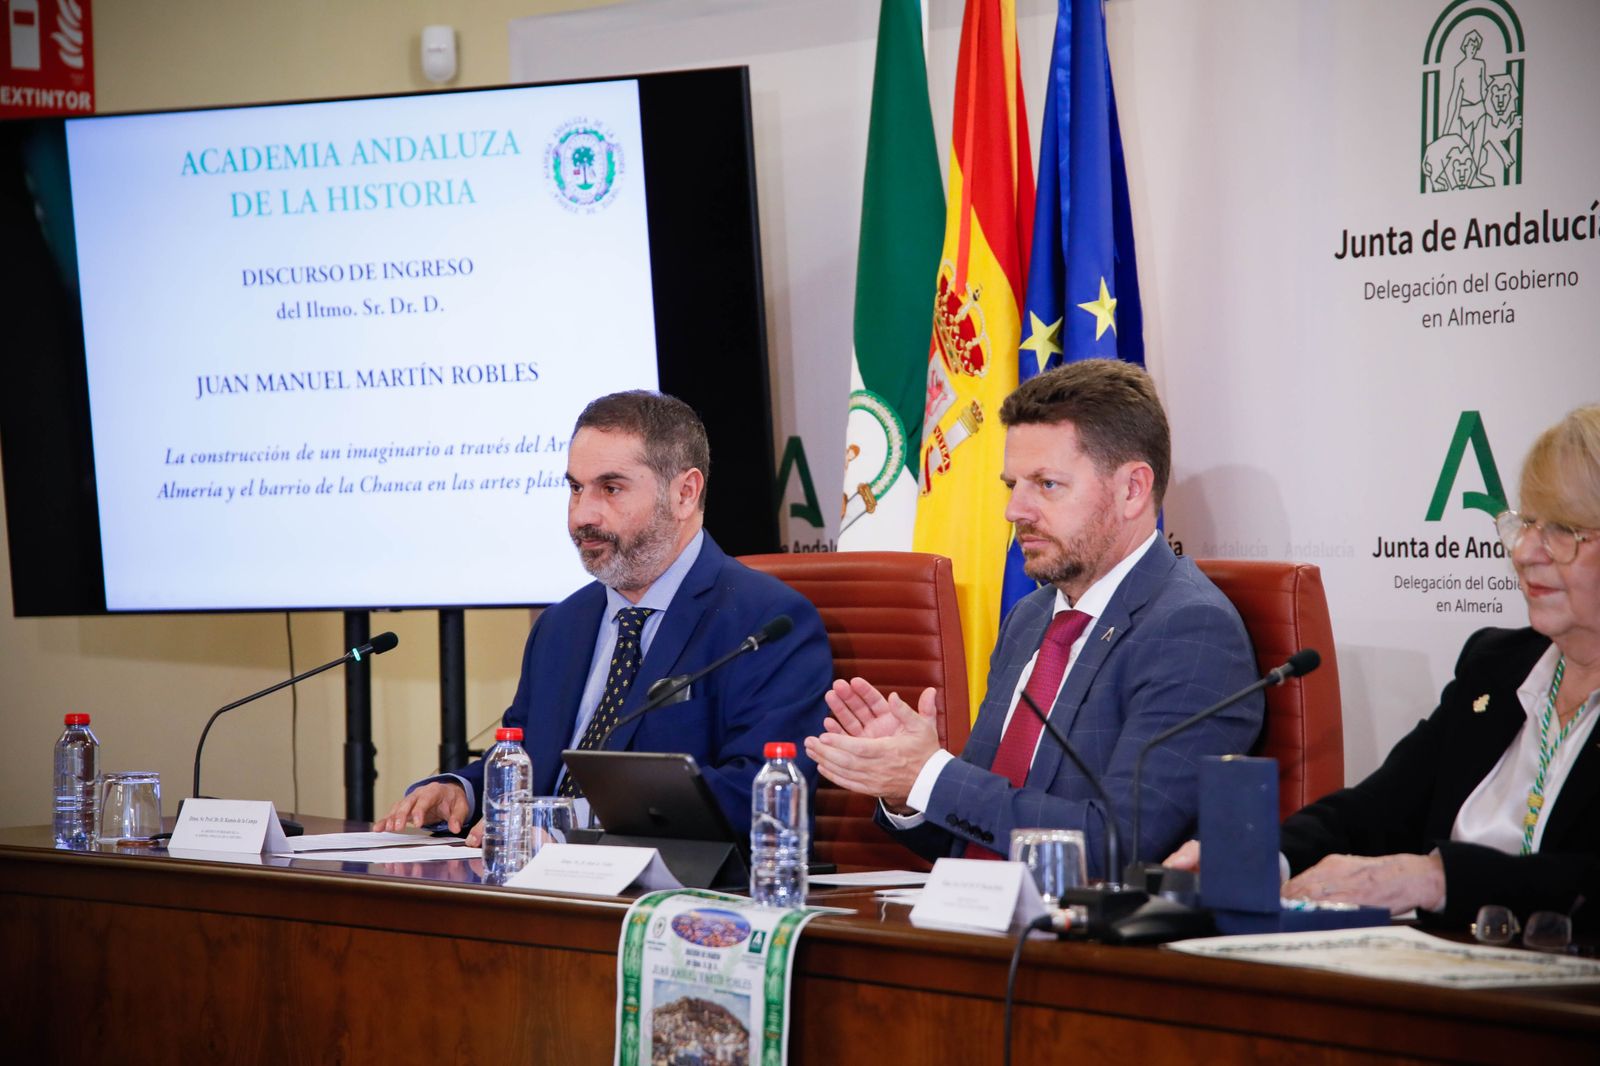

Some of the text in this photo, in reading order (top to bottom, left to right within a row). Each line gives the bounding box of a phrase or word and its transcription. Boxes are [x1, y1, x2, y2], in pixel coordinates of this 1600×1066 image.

[0, 86, 91, 111] EXTINTOR
[181, 129, 521, 176] ACADEMIA ANDALUZA
[230, 178, 478, 218] DE LA HISTORIA
[1334, 226, 1413, 260] Junta
[1422, 219, 1456, 253] de
[242, 258, 474, 287] DISCURSO DE INGRESO
[1364, 269, 1579, 303] Delegación del Gobierno
[276, 295, 444, 320] del Iltmo. Sr. Dr. D.
[1422, 302, 1515, 328] en Almería
[195, 362, 539, 400] JUAN MANUEL MARTÍN ROBLES
[165, 448, 185, 465] La
[190, 445, 290, 464] construcción
[296, 443, 314, 461] de
[320, 449, 341, 460] un
[347, 441, 440, 464] imaginario
[444, 445, 454, 456] a
[460, 438, 510, 455] través
[515, 435, 540, 453] del
[157, 481, 222, 499] Almería
[225, 487, 235, 503] y
[240, 478, 254, 496] el
[259, 478, 311, 496] barrio
[315, 477, 333, 494] de
[338, 476, 354, 493] la
[360, 475, 422, 493] Chanca
[428, 481, 446, 492] en
[452, 473, 474, 490] las
[480, 476, 520, 490] artes
[1372, 535, 1510, 558] Junta de And
[1394, 574, 1461, 593] Delegación
[1465, 575, 1484, 590] del
[1436, 597, 1503, 613] en Almería
